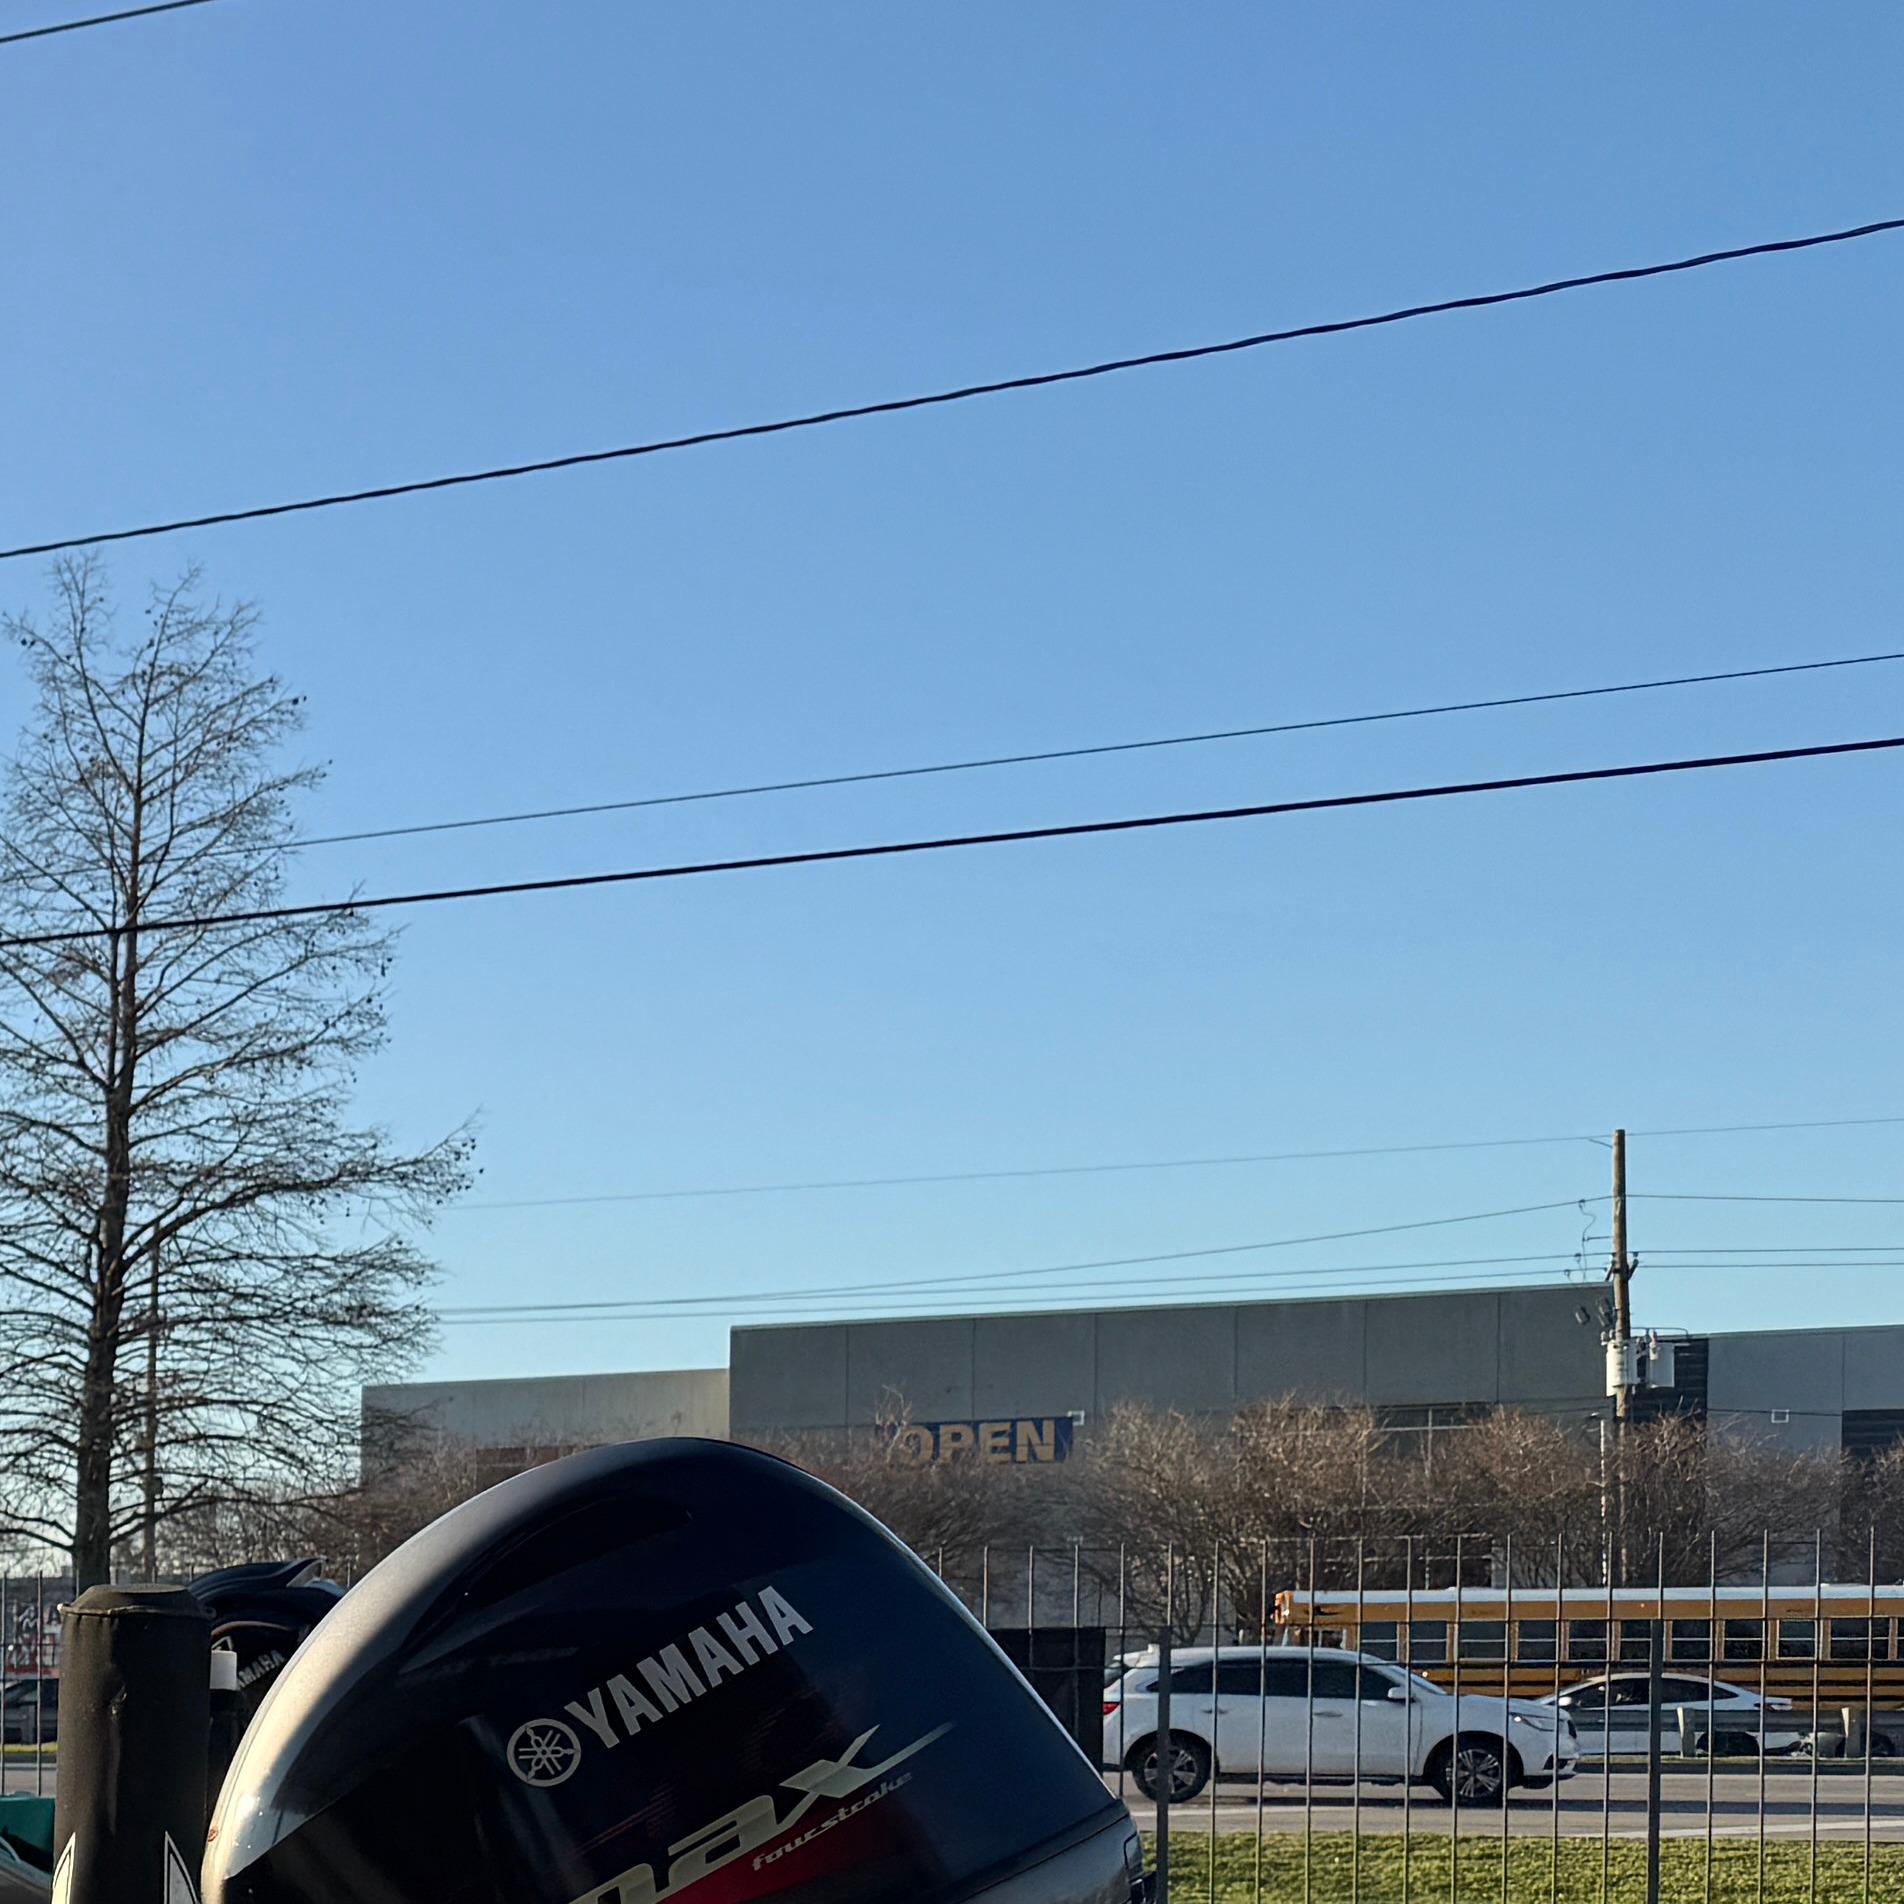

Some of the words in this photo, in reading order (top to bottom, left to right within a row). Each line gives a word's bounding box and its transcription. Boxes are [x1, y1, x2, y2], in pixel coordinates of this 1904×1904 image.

[893, 1420, 1056, 1468] OPEN
[237, 1649, 286, 1689] MAHA
[563, 1586, 814, 1749] YAMAHA
